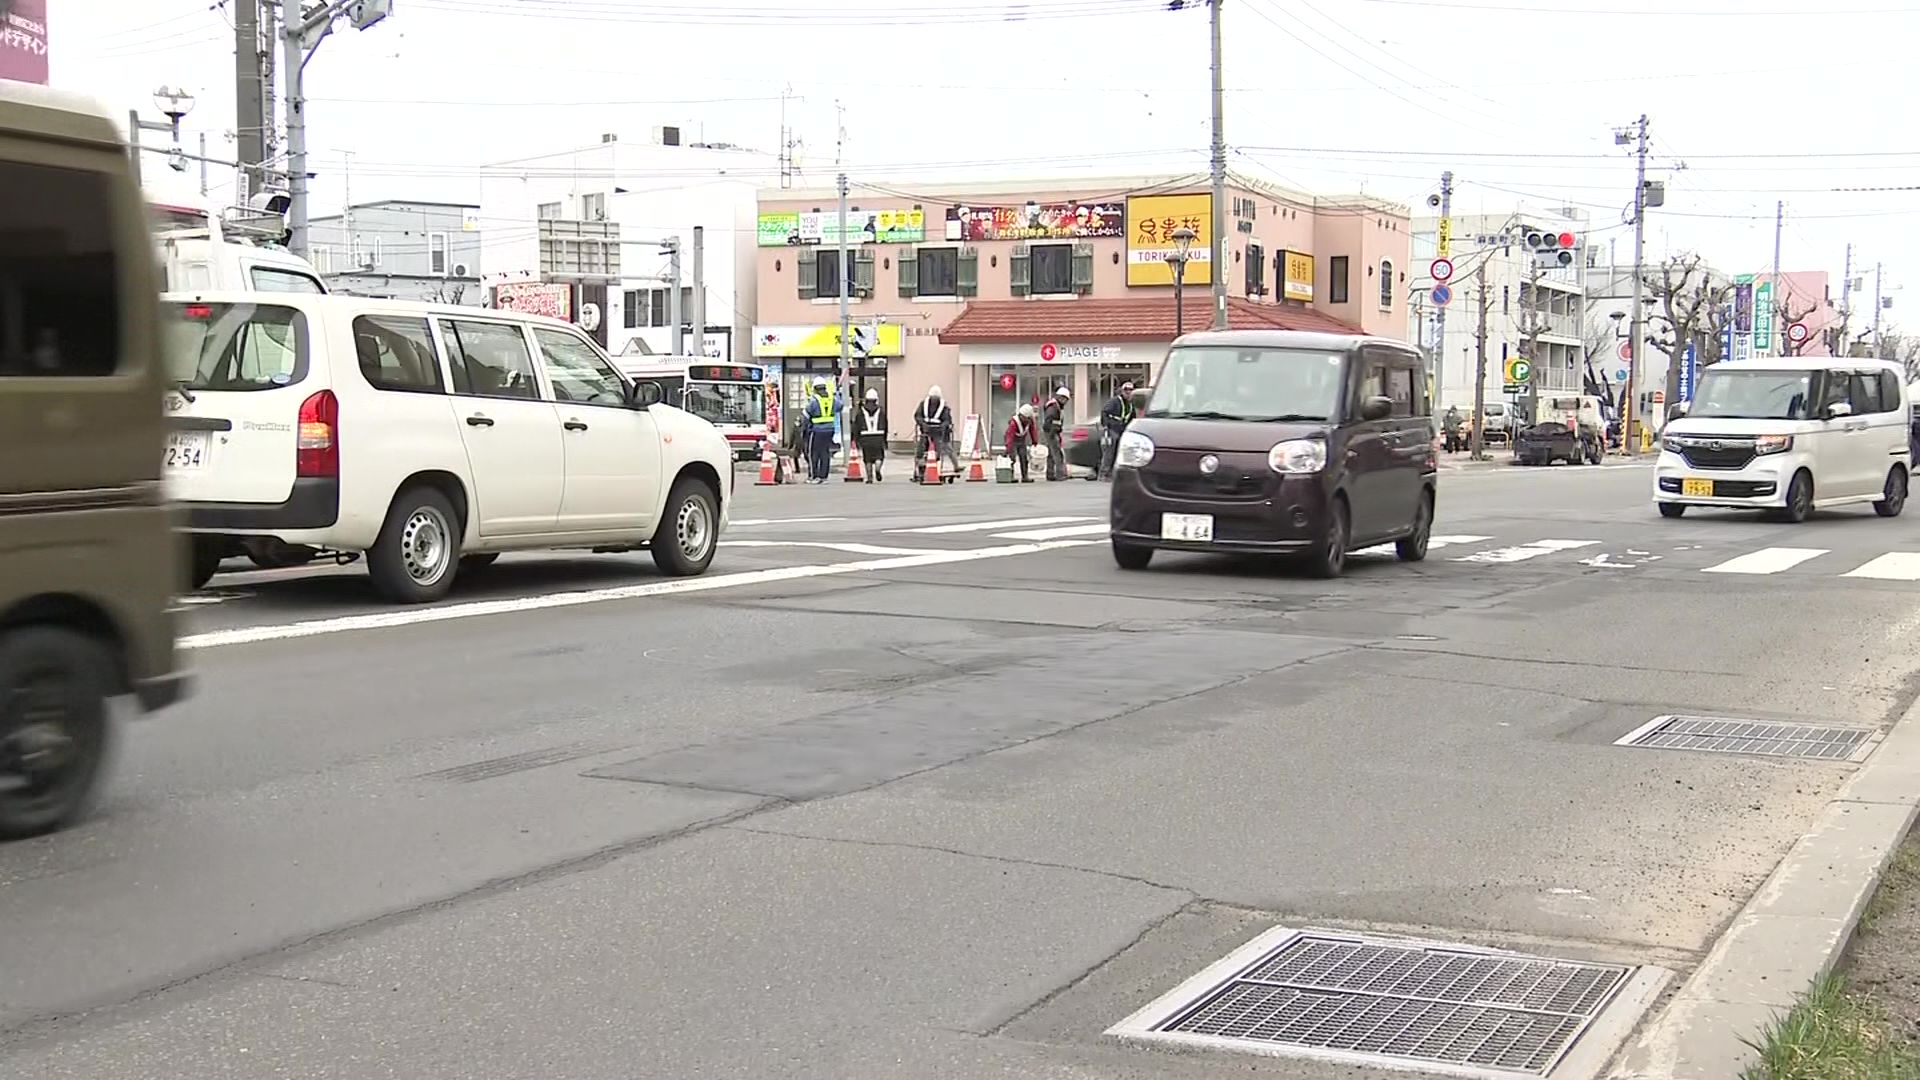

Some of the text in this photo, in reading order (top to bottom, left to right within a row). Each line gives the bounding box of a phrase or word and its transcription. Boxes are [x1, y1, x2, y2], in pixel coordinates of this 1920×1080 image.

[0, 27, 47, 55] ドデザイン
[1138, 250, 1201, 262] TORIKKU
[1435, 264, 1449, 276] 50
[1060, 346, 1098, 358] PLAGE
[1515, 363, 1529, 379] P
